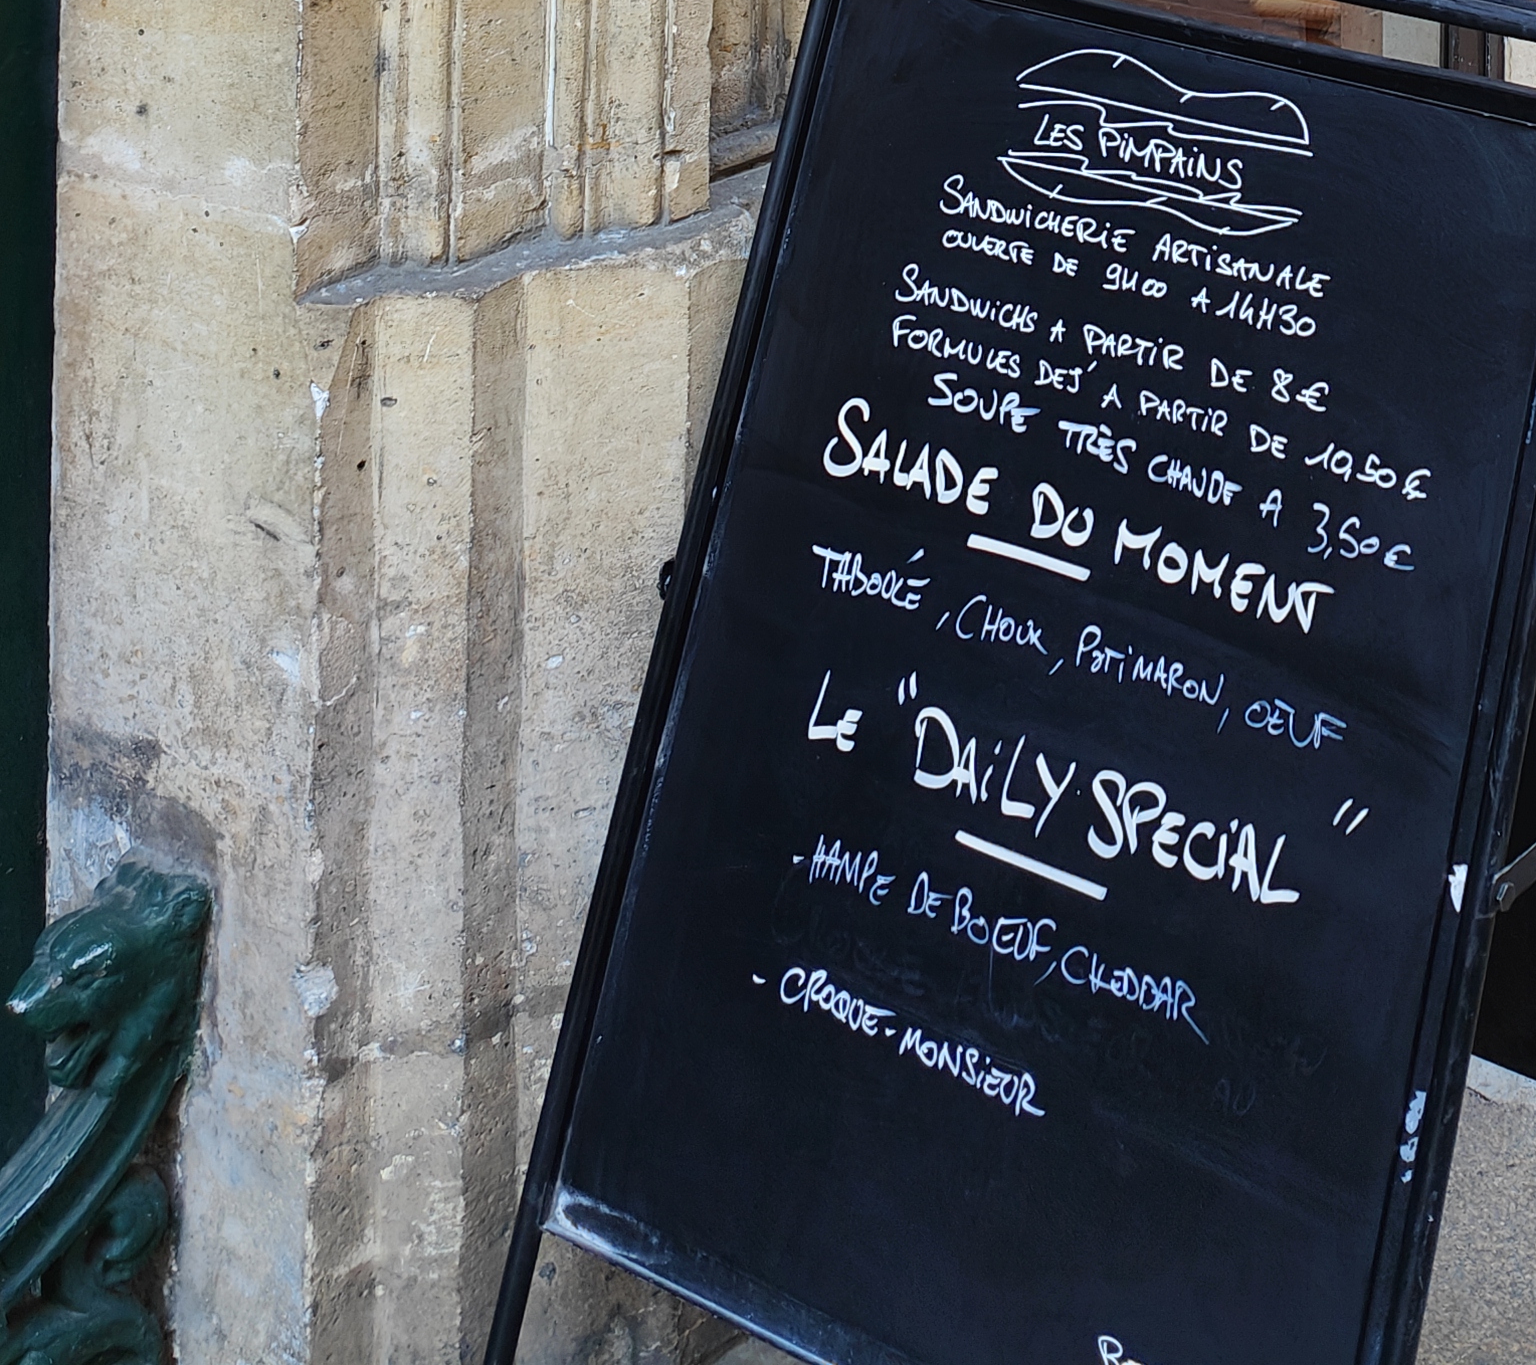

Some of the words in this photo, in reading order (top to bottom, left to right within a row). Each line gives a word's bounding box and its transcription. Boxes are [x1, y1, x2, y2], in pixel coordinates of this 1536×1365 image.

[1034, 113, 1083, 150] LES
[941, 227, 1034, 266] OUVERTE
[1052, 251, 1079, 277] DE
[1191, 290, 1211, 314] A
[1215, 291, 1317, 339] 14H30
[892, 315, 1020, 379] FORMULES
[1101, 386, 1121, 411] A
[1249, 424, 1286, 460] DE
[1049, 319, 1067, 344] A
[1209, 360, 1255, 393] DE
[927, 372, 1041, 434] SOUPE
[1058, 419, 1136, 474] TRÈS
[1146, 454, 1243, 506] CHAUDE
[1260, 488, 1282, 528] A
[823, 397, 999, 516] SALADE
[1032, 483, 1094, 547] DU
[1113, 518, 1334, 635] MOMENT
[808, 669, 863, 752] LE
[907, 871, 952, 919] DE
